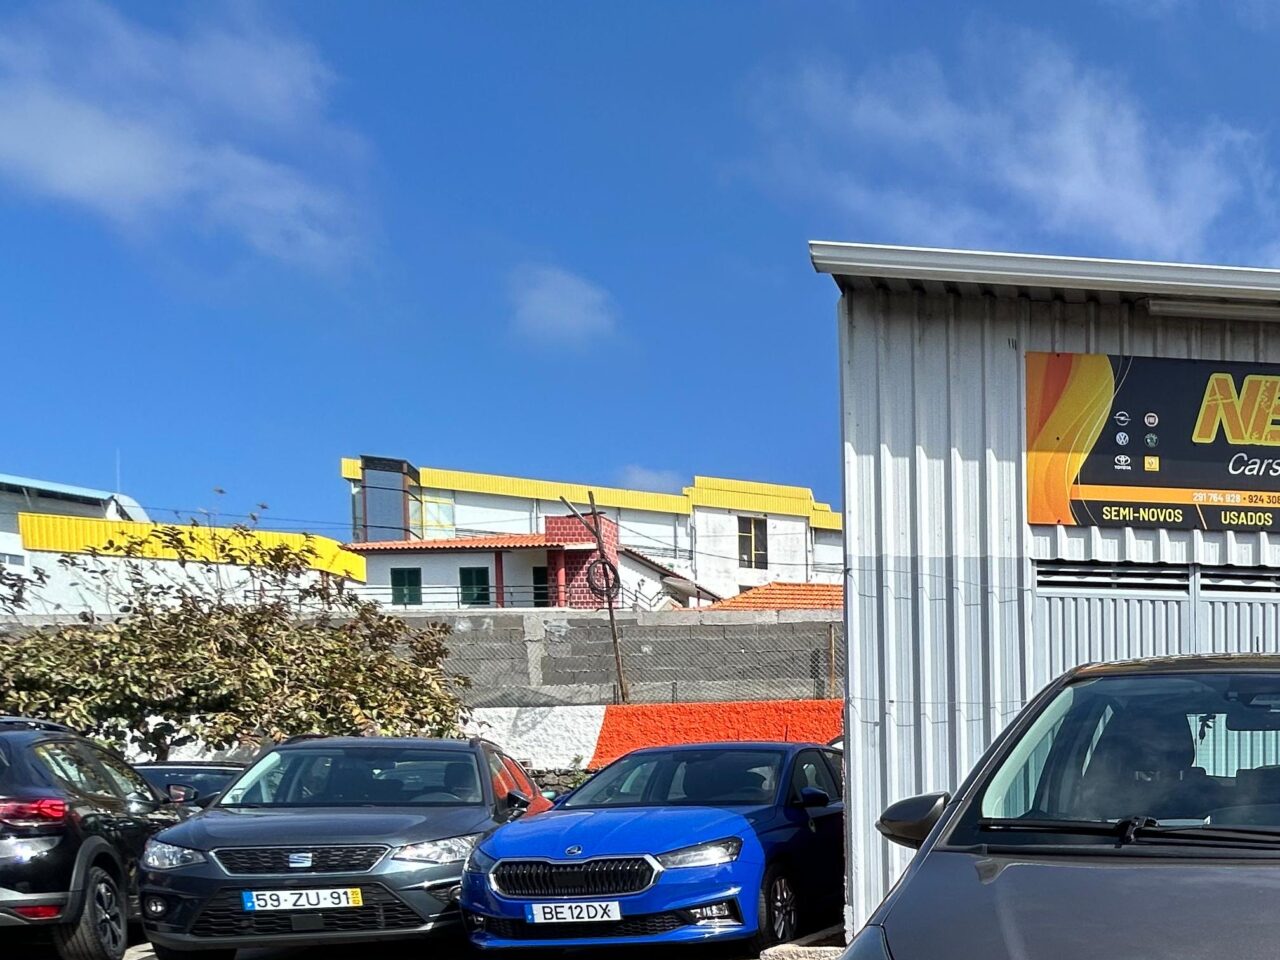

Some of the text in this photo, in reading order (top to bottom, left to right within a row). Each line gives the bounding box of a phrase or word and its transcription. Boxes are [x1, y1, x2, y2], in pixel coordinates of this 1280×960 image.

[1248, 494, 1264, 504] 924
[1102, 506, 1183, 522] SEMI-NOVOS
[1221, 511, 1273, 525] USADOS
